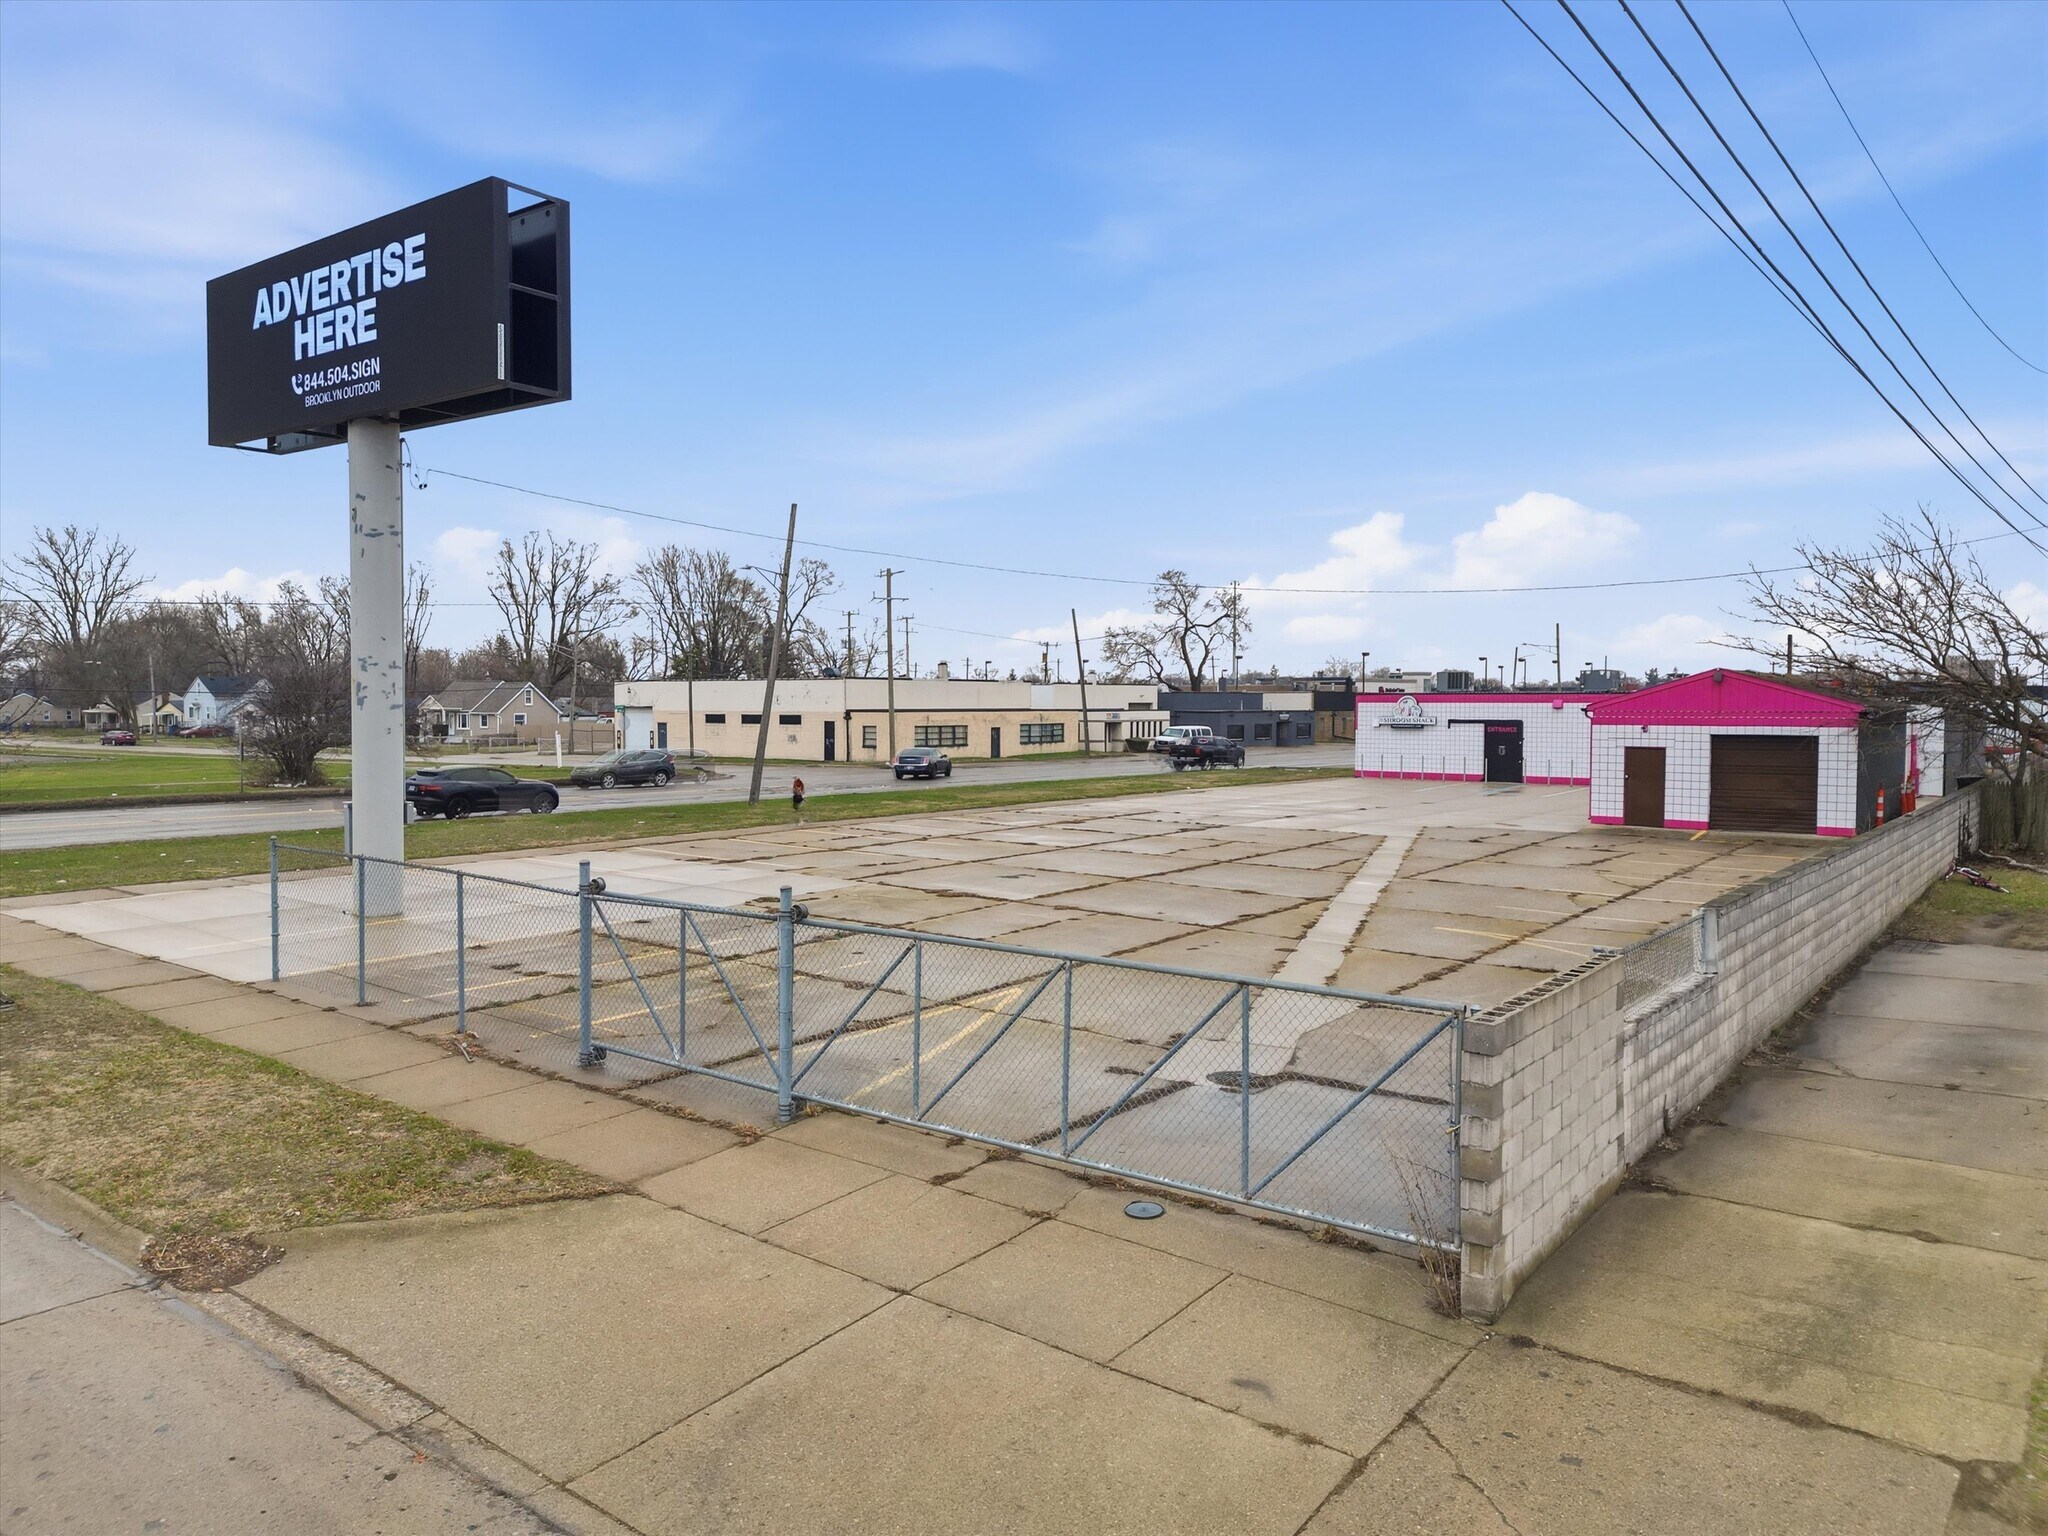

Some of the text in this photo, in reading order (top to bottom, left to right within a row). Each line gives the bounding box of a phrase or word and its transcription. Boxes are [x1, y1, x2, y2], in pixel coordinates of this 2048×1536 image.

[253, 233, 426, 330] ADVERTISE
[294, 297, 377, 361] HERE
[303, 356, 380, 392] 844.504.SIGN
[304, 379, 381, 408] BROOKLYN OUTDOOR
